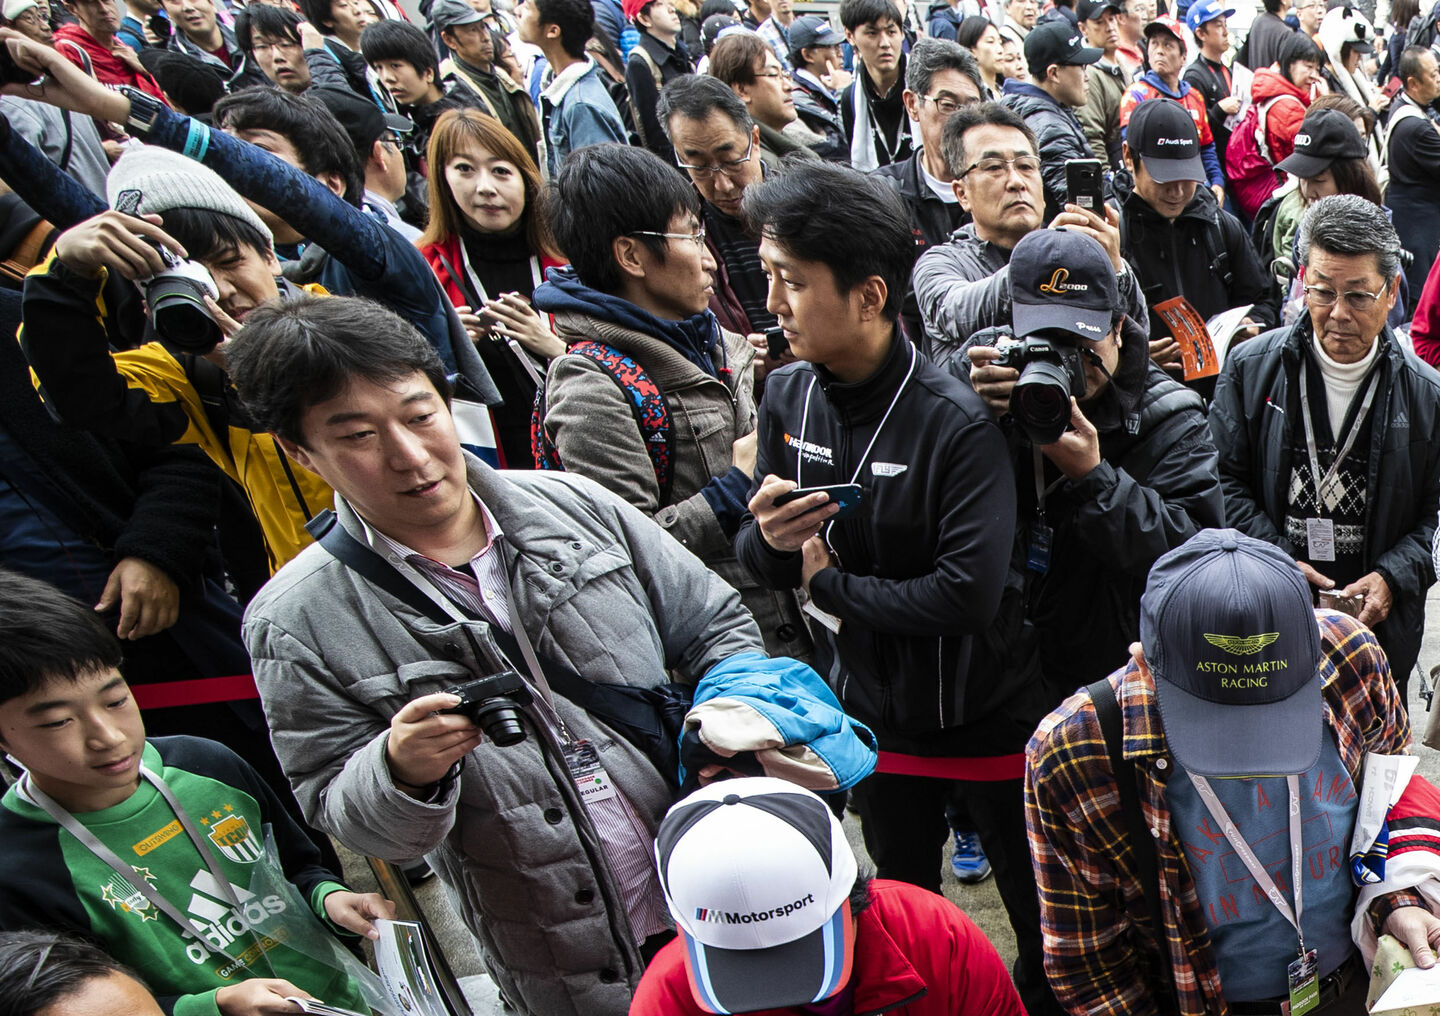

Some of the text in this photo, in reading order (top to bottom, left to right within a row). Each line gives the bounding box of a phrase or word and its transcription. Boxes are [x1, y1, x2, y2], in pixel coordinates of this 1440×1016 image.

[1196, 659, 1288, 674] ASTON MARTIN
[1221, 676, 1268, 688] RACING
[724, 893, 815, 924] Motorsport
[186, 895, 287, 965] adidas
